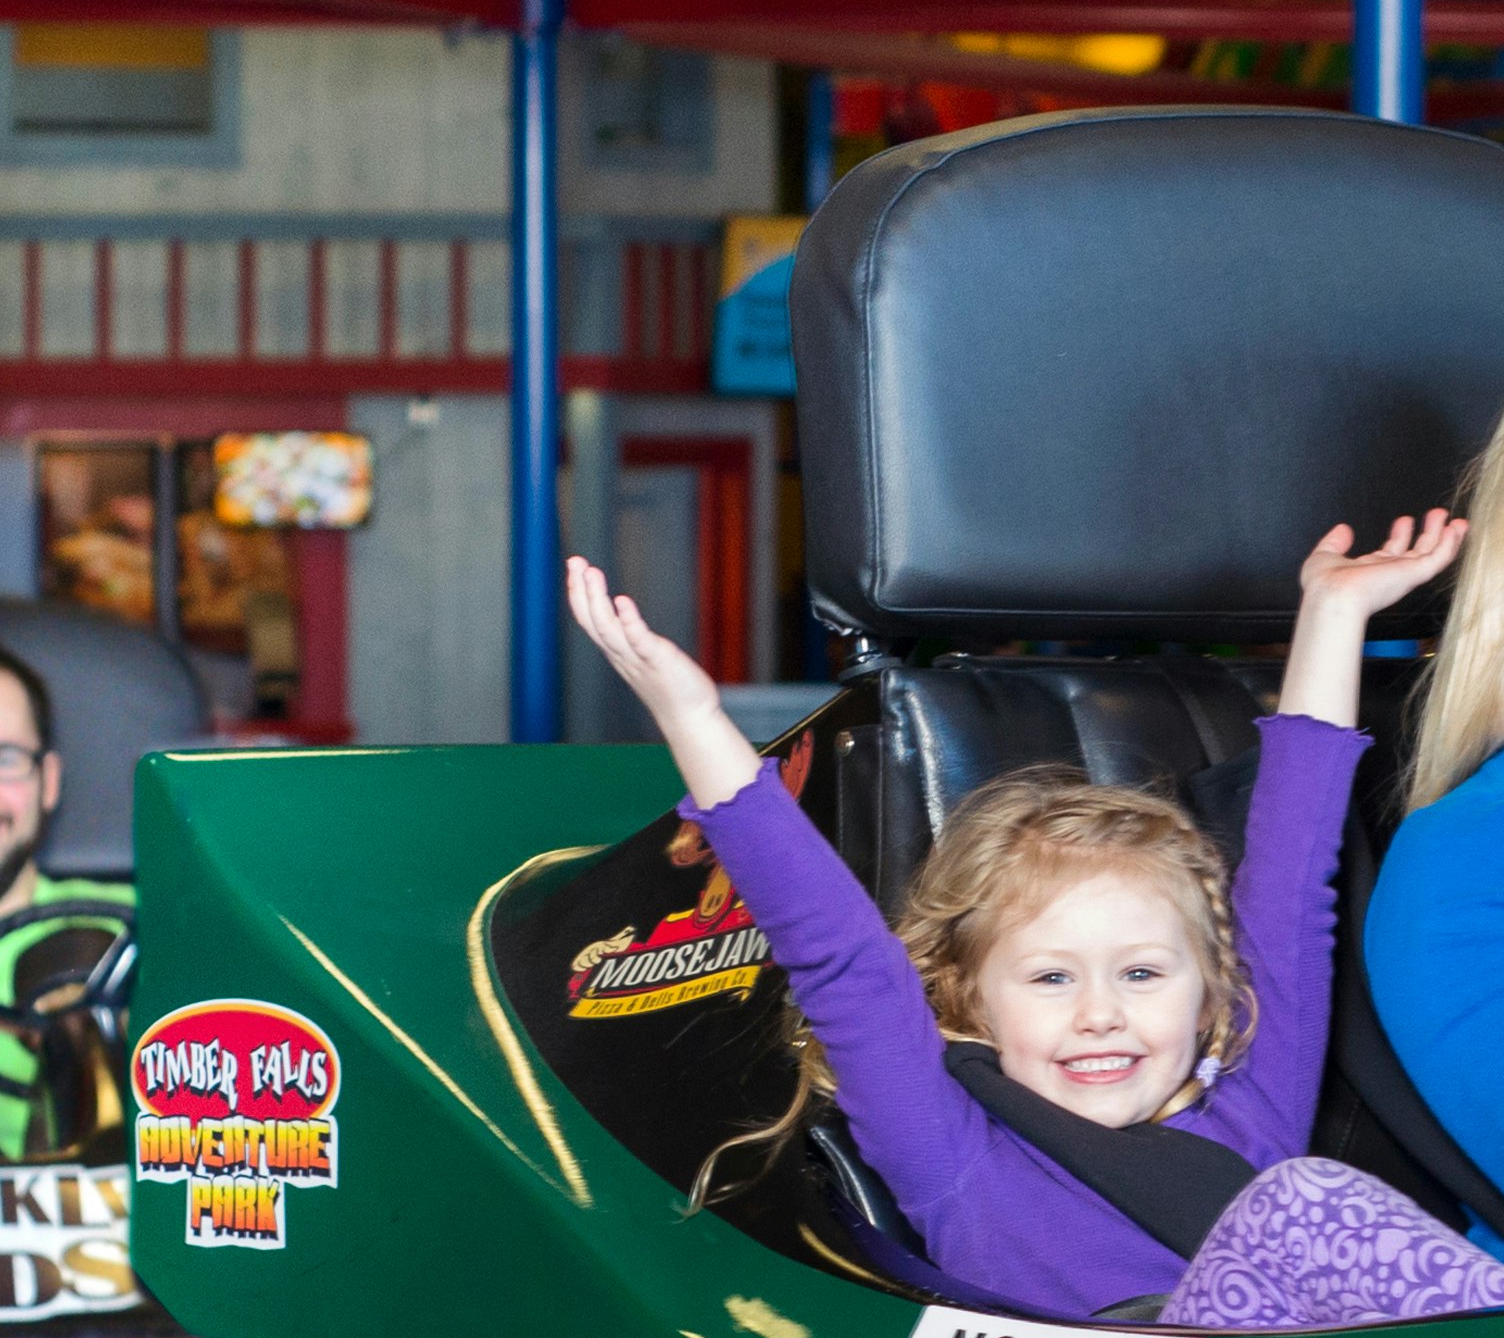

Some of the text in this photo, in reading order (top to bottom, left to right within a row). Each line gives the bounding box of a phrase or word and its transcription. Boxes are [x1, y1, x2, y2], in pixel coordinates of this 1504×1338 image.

[587, 969, 747, 1015] Pizza & Dells Brewing Co.
[141, 1039, 328, 1112] TIMBER FALLS
[139, 1115, 331, 1176] ADVENTURE
[191, 1174, 279, 1239] PARK
